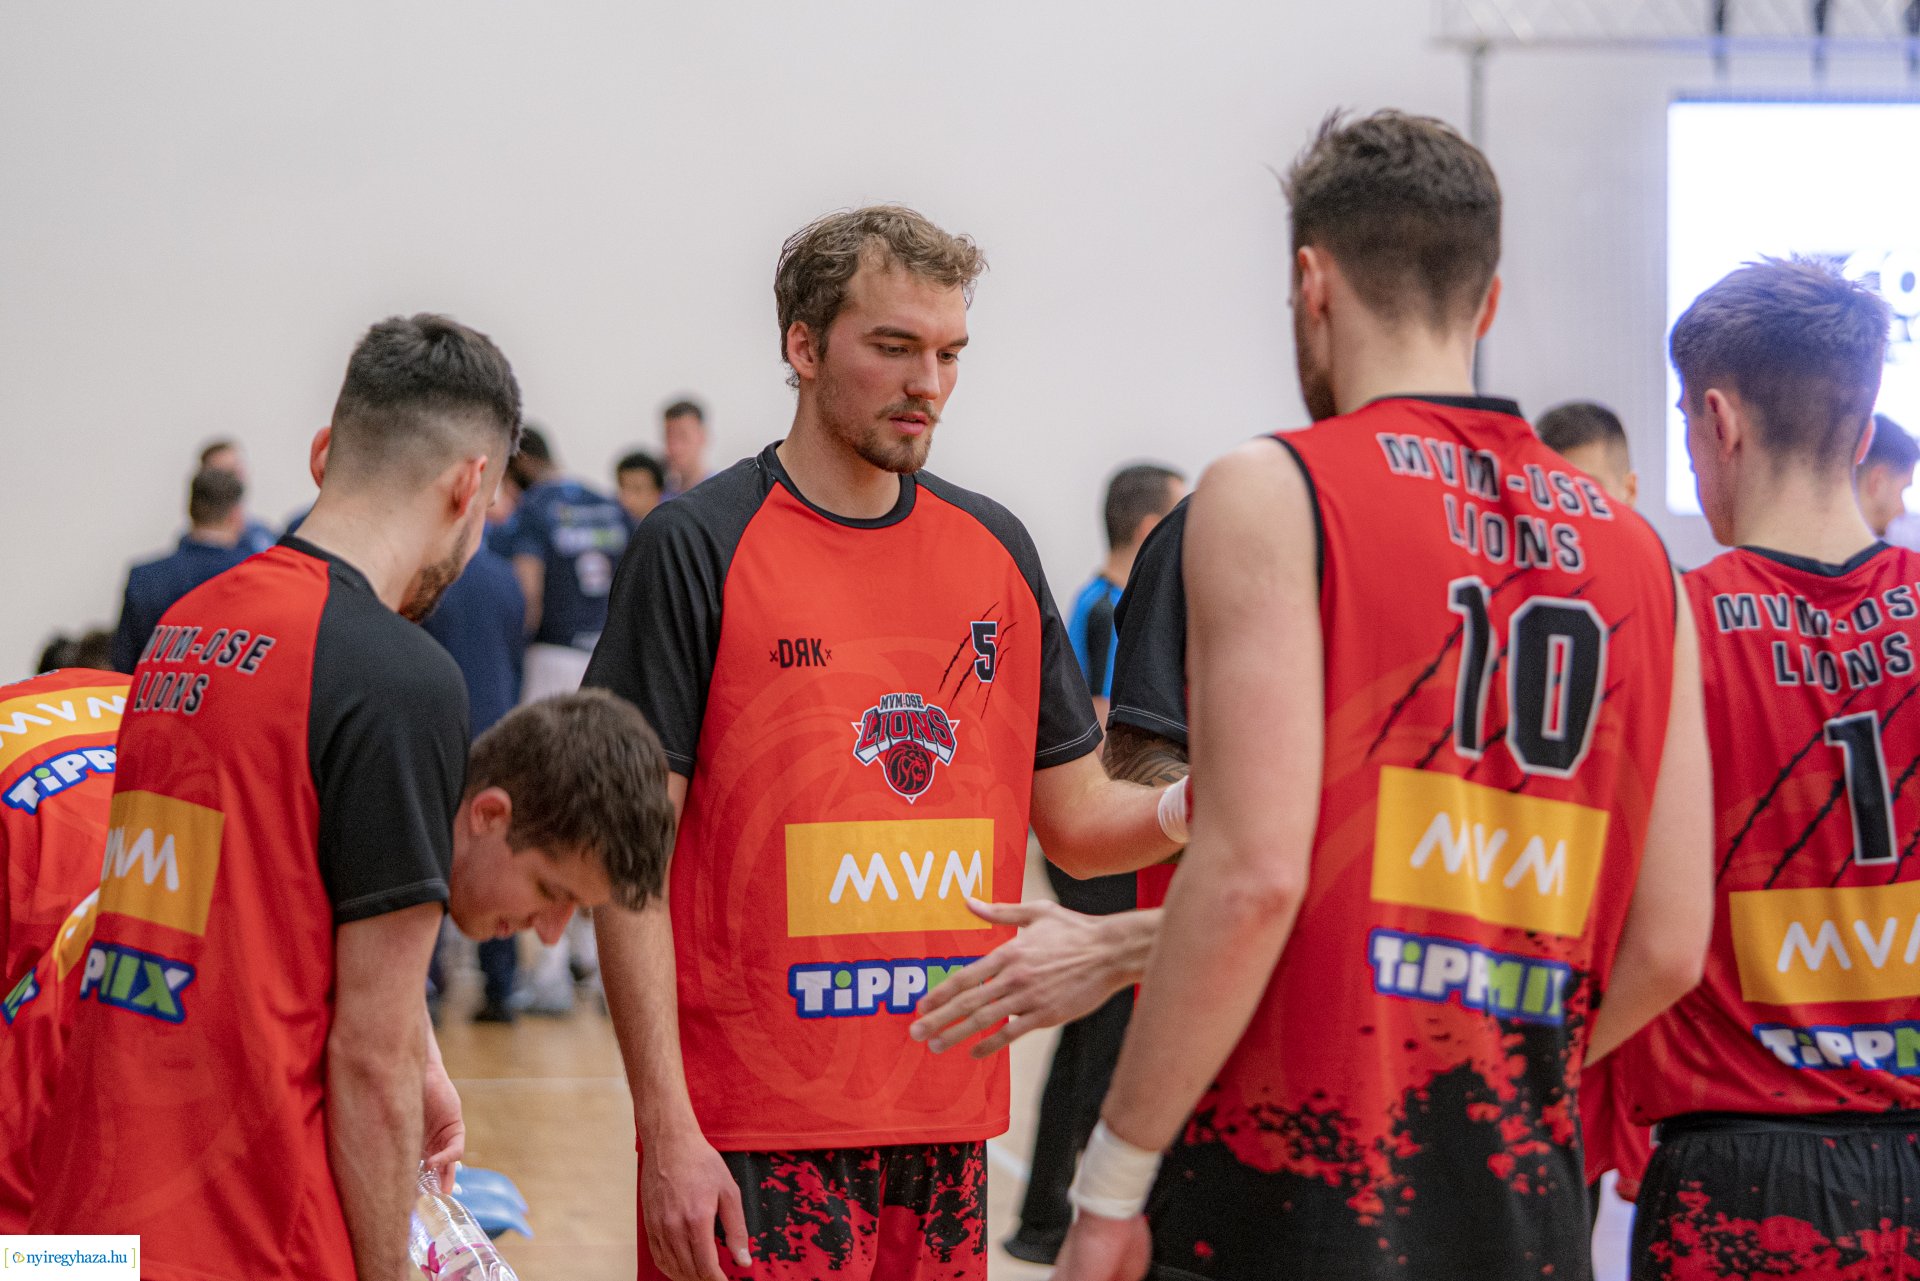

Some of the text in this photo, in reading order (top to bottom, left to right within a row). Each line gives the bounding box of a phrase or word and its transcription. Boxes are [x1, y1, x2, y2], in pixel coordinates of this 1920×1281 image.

[1376, 432, 1614, 520] MVM-OSE
[1443, 494, 1585, 573] LIONS
[1713, 582, 1920, 638] MVM-OS
[970, 621, 998, 683] 5
[1447, 575, 1609, 779] 10
[1771, 631, 1914, 693] LIONS
[133, 671, 210, 716] LIONS
[880, 693, 925, 710] MVM-OSE
[858, 709, 954, 750] LIONS
[8, 745, 117, 810] TiPP
[1824, 710, 1898, 865] 1
[828, 849, 983, 904] MVM
